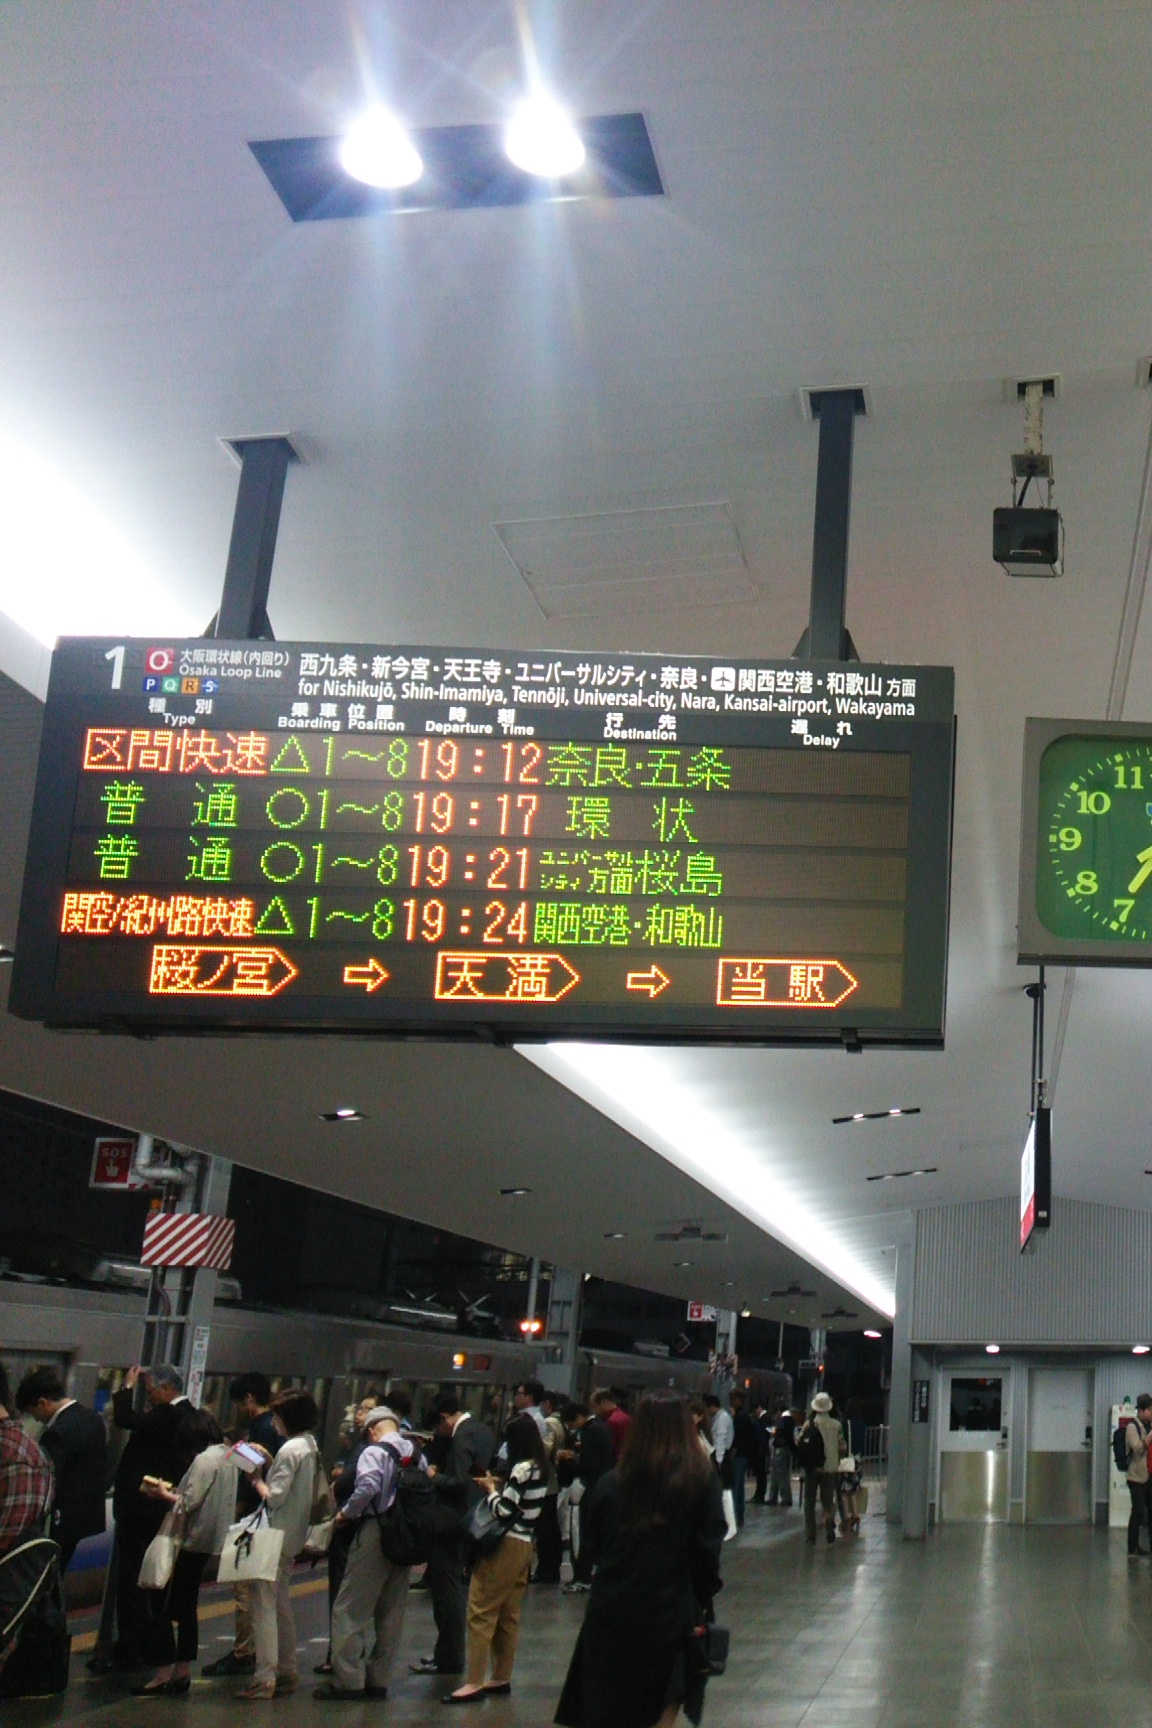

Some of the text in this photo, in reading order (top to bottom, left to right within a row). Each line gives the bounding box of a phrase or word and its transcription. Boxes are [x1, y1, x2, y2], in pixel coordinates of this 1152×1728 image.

[104, 645, 126, 690] 1
[221, 666, 252, 679] Loop
[255, 666, 282, 678] Line
[145, 678, 155, 690] P
[164, 678, 177, 691] Q
[185, 679, 196, 692] R
[887, 678, 916, 697] 方面
[298, 679, 915, 719] for Nishikujō, Shin-Imamiya, Tennōji, Universal-city, Nara, Kansai-airport, Wakayama
[163, 712, 840, 749] Type Boarding Position Departure Time Destination Delay
[83, 728, 268, 776] 区間快速
[417, 739, 541, 784] 19:12
[545, 742, 731, 791] 奈良・五条
[1114, 766, 1144, 789] 11
[413, 792, 537, 835] 19:17
[1077, 791, 1111, 815] 10
[1058, 828, 1082, 851] 9
[408, 845, 527, 889] 19:21
[634, 849, 722, 897] 桜島
[1075, 871, 1098, 895] 8
[1114, 899, 1135, 922] 7
[403, 899, 527, 944] 19:24
[534, 902, 723, 947] 関西空港・和歌山
[443, 955, 552, 998] 天満
[731, 961, 826, 1002] 当駅
[101, 1147, 128, 1159] SOS
